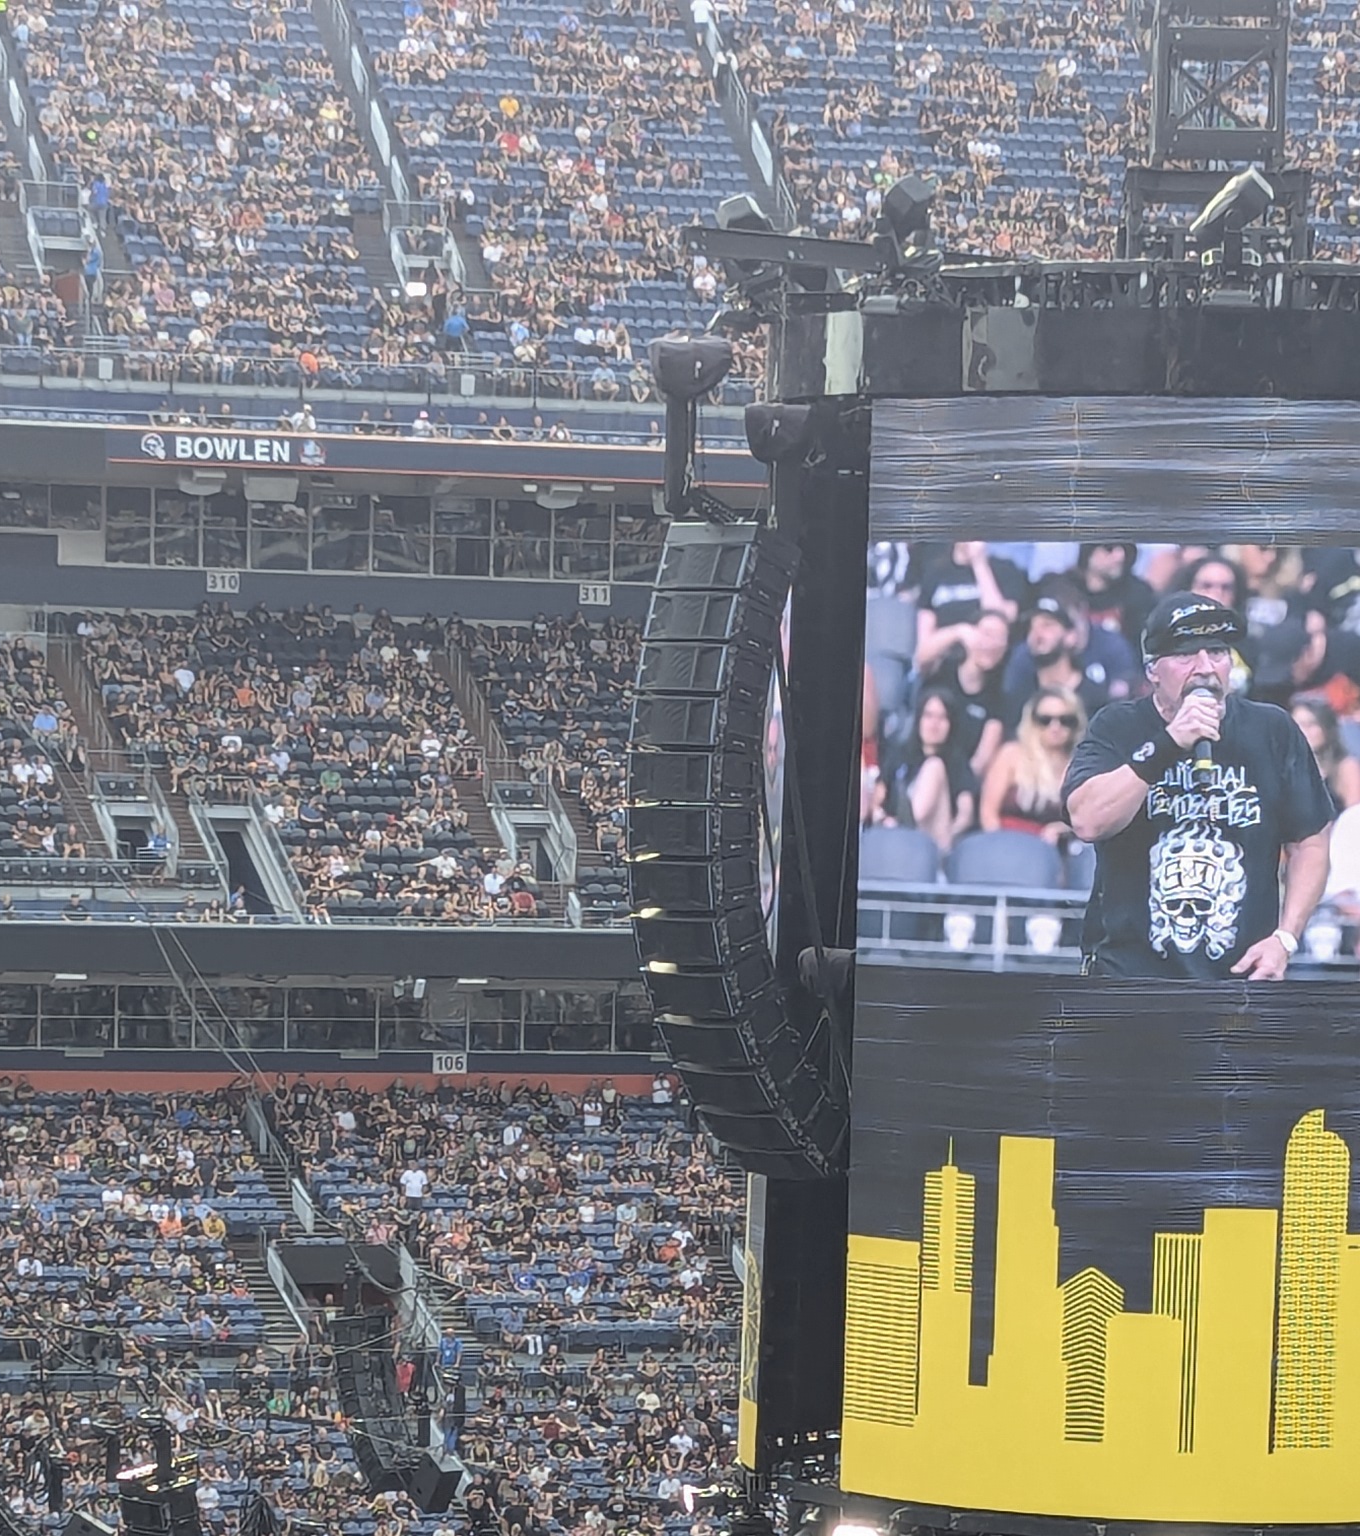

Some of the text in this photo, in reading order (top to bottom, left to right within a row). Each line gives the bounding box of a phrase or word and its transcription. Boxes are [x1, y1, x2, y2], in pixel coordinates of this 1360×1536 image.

[175, 437, 291, 463] BOWLEN
[208, 575, 239, 590] 310
[581, 587, 608, 601] 311
[436, 1056, 464, 1071] 106
